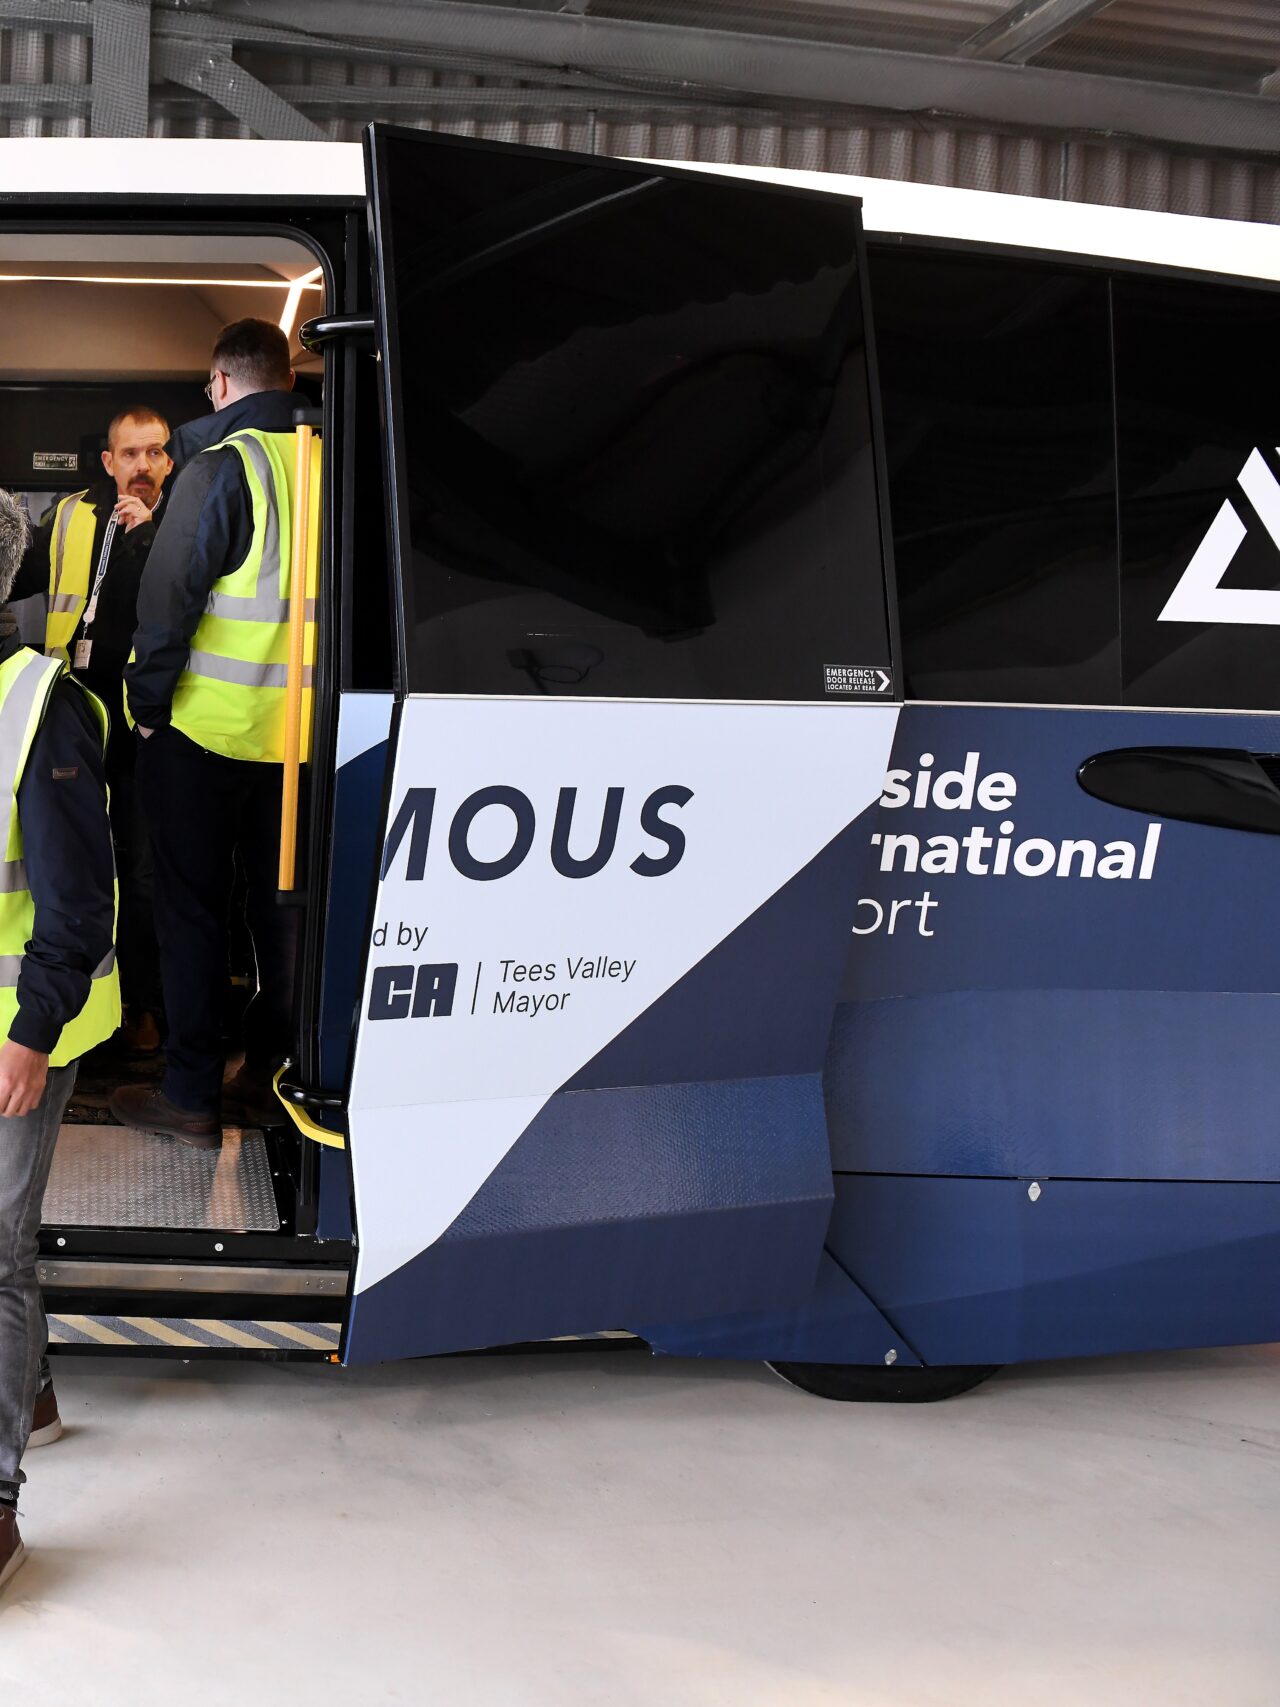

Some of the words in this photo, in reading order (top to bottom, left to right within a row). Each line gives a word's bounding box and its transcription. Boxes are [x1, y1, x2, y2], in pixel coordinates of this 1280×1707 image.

[827, 668, 874, 677] EMERGENCY
[849, 677, 875, 685] RELEASE
[879, 752, 1017, 812] side
[871, 820, 1161, 880] national
[397, 922, 429, 952] by
[500, 959, 557, 983] Tees
[567, 956, 637, 983] Valley
[493, 990, 571, 1018] Mayor
